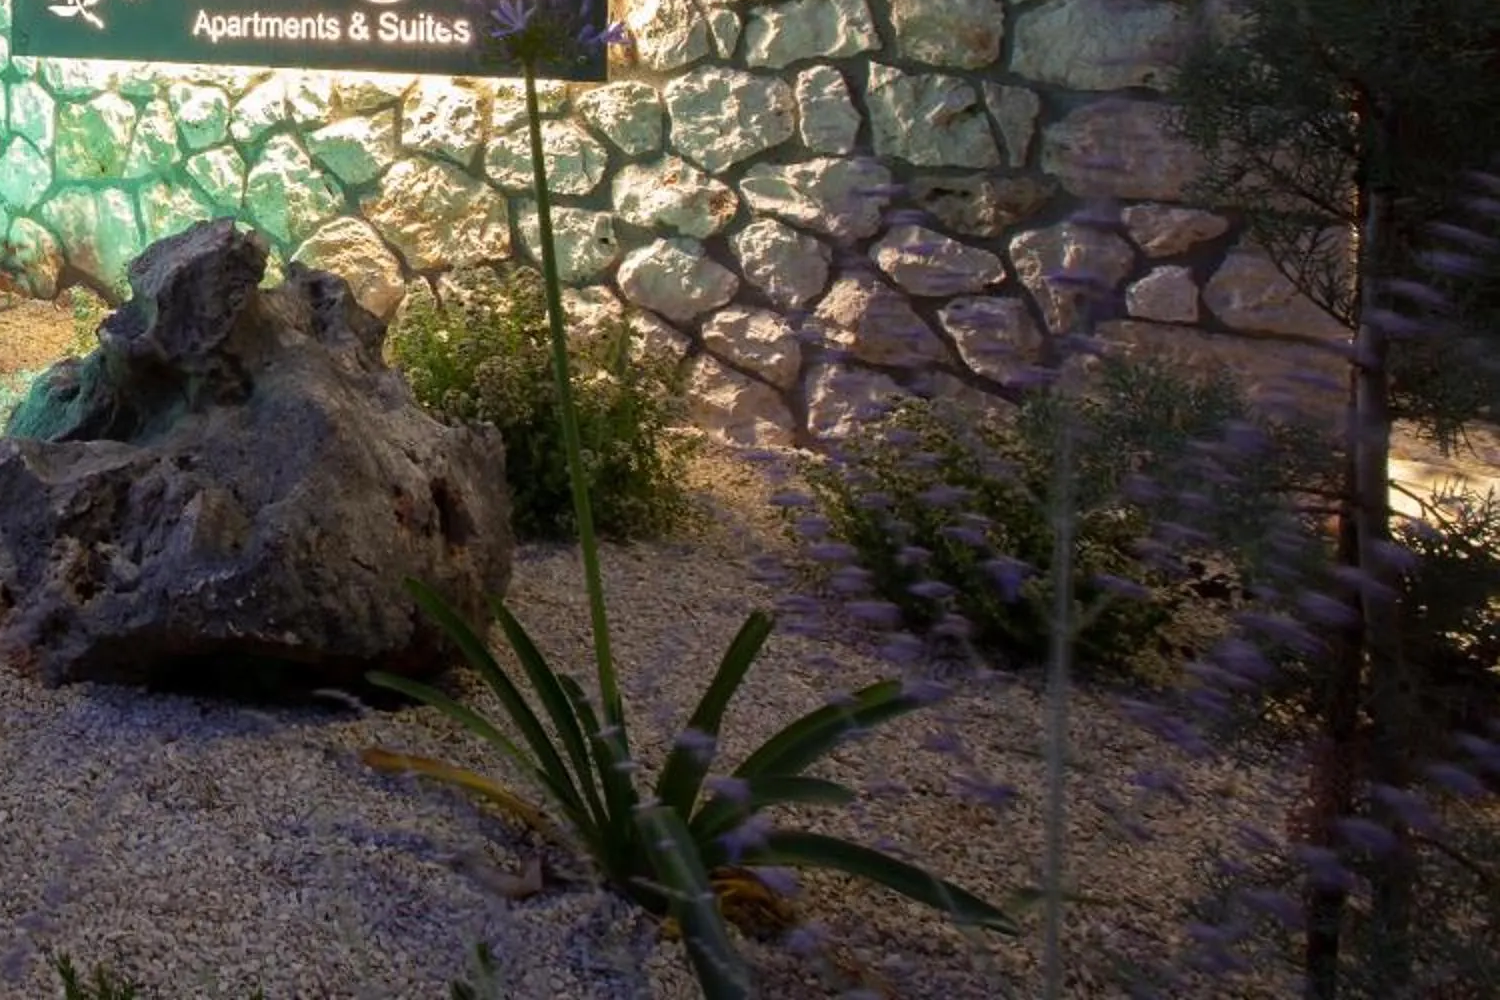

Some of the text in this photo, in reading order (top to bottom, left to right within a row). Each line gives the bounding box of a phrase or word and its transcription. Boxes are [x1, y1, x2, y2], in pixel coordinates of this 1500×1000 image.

[192, 9, 472, 45] Apartments & Suites
